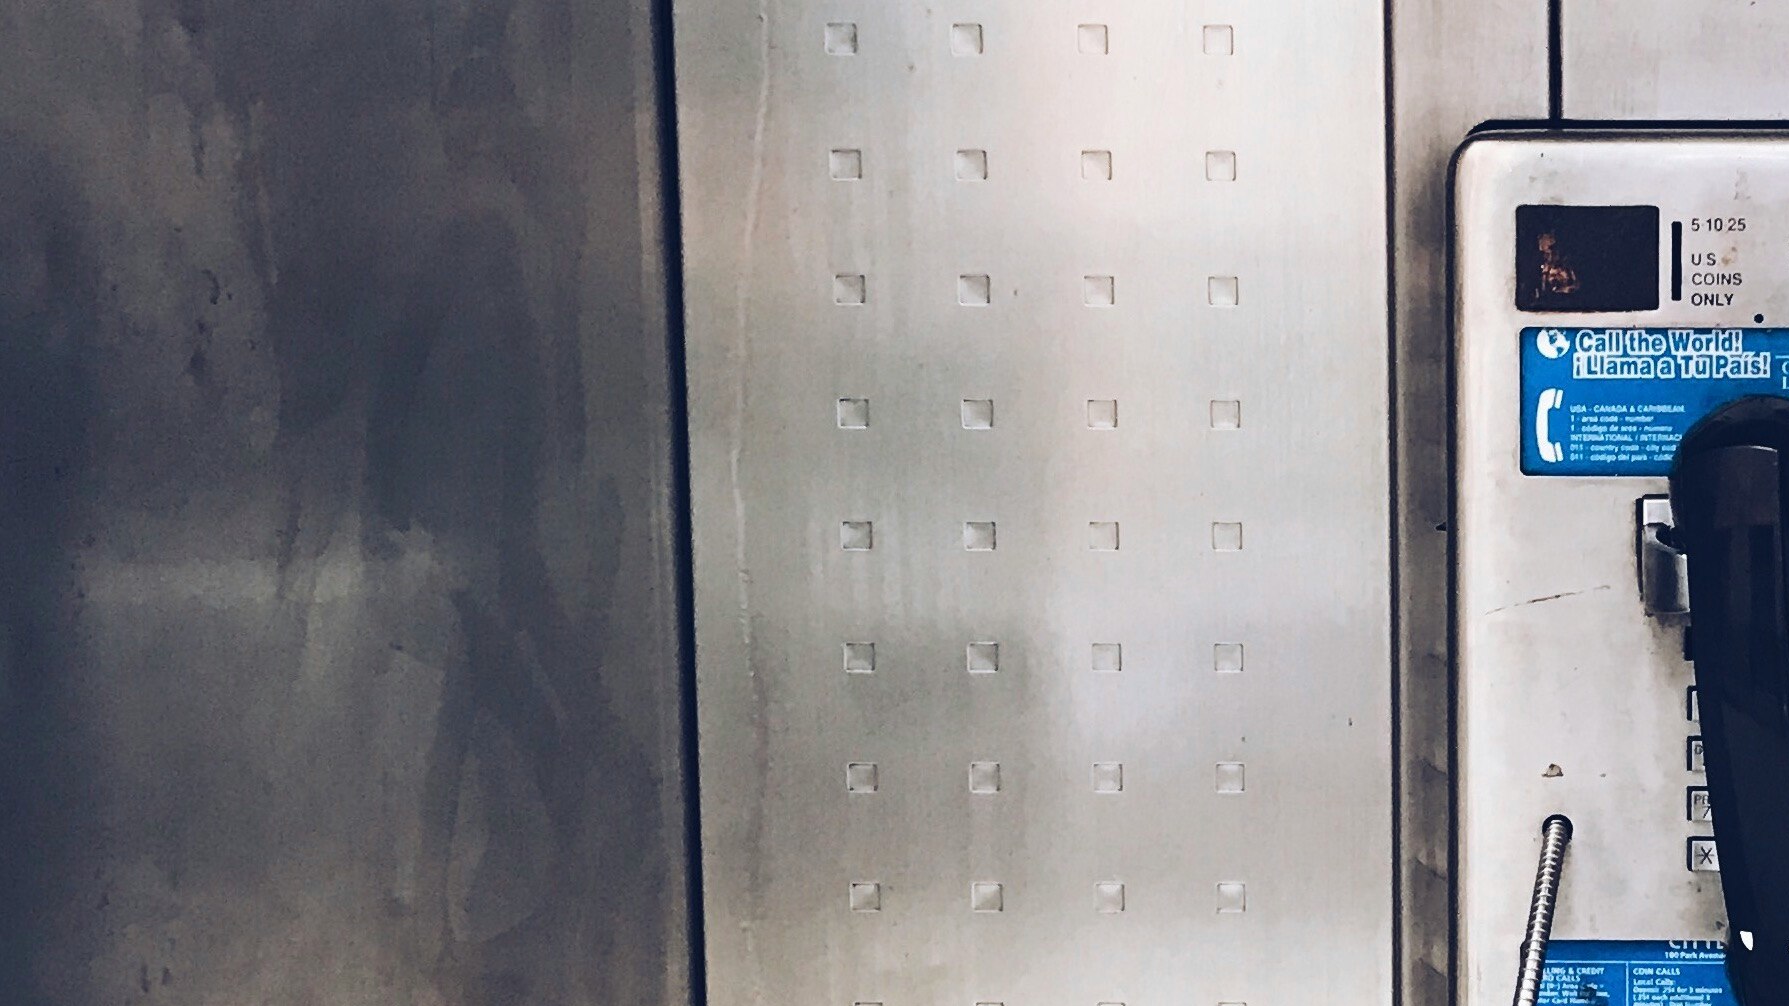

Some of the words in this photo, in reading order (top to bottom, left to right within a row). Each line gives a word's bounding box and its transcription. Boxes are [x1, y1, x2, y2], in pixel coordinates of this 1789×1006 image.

[1691, 218, 1700, 231] 5
[1706, 218, 1725, 231] 10
[1728, 218, 1747, 231] 25
[1691, 273, 1743, 286] COINS
[1691, 294, 1735, 307] ONLY
[1575, 330, 1623, 354] Call
[1626, 330, 1667, 354] the
[1668, 330, 1743, 354] World!
[1656, 357, 1676, 379] a
[1632, 967, 1654, 975] COIN
[1655, 967, 1681, 975] CALLS
[1555, 974, 1581, 982] CALLS
